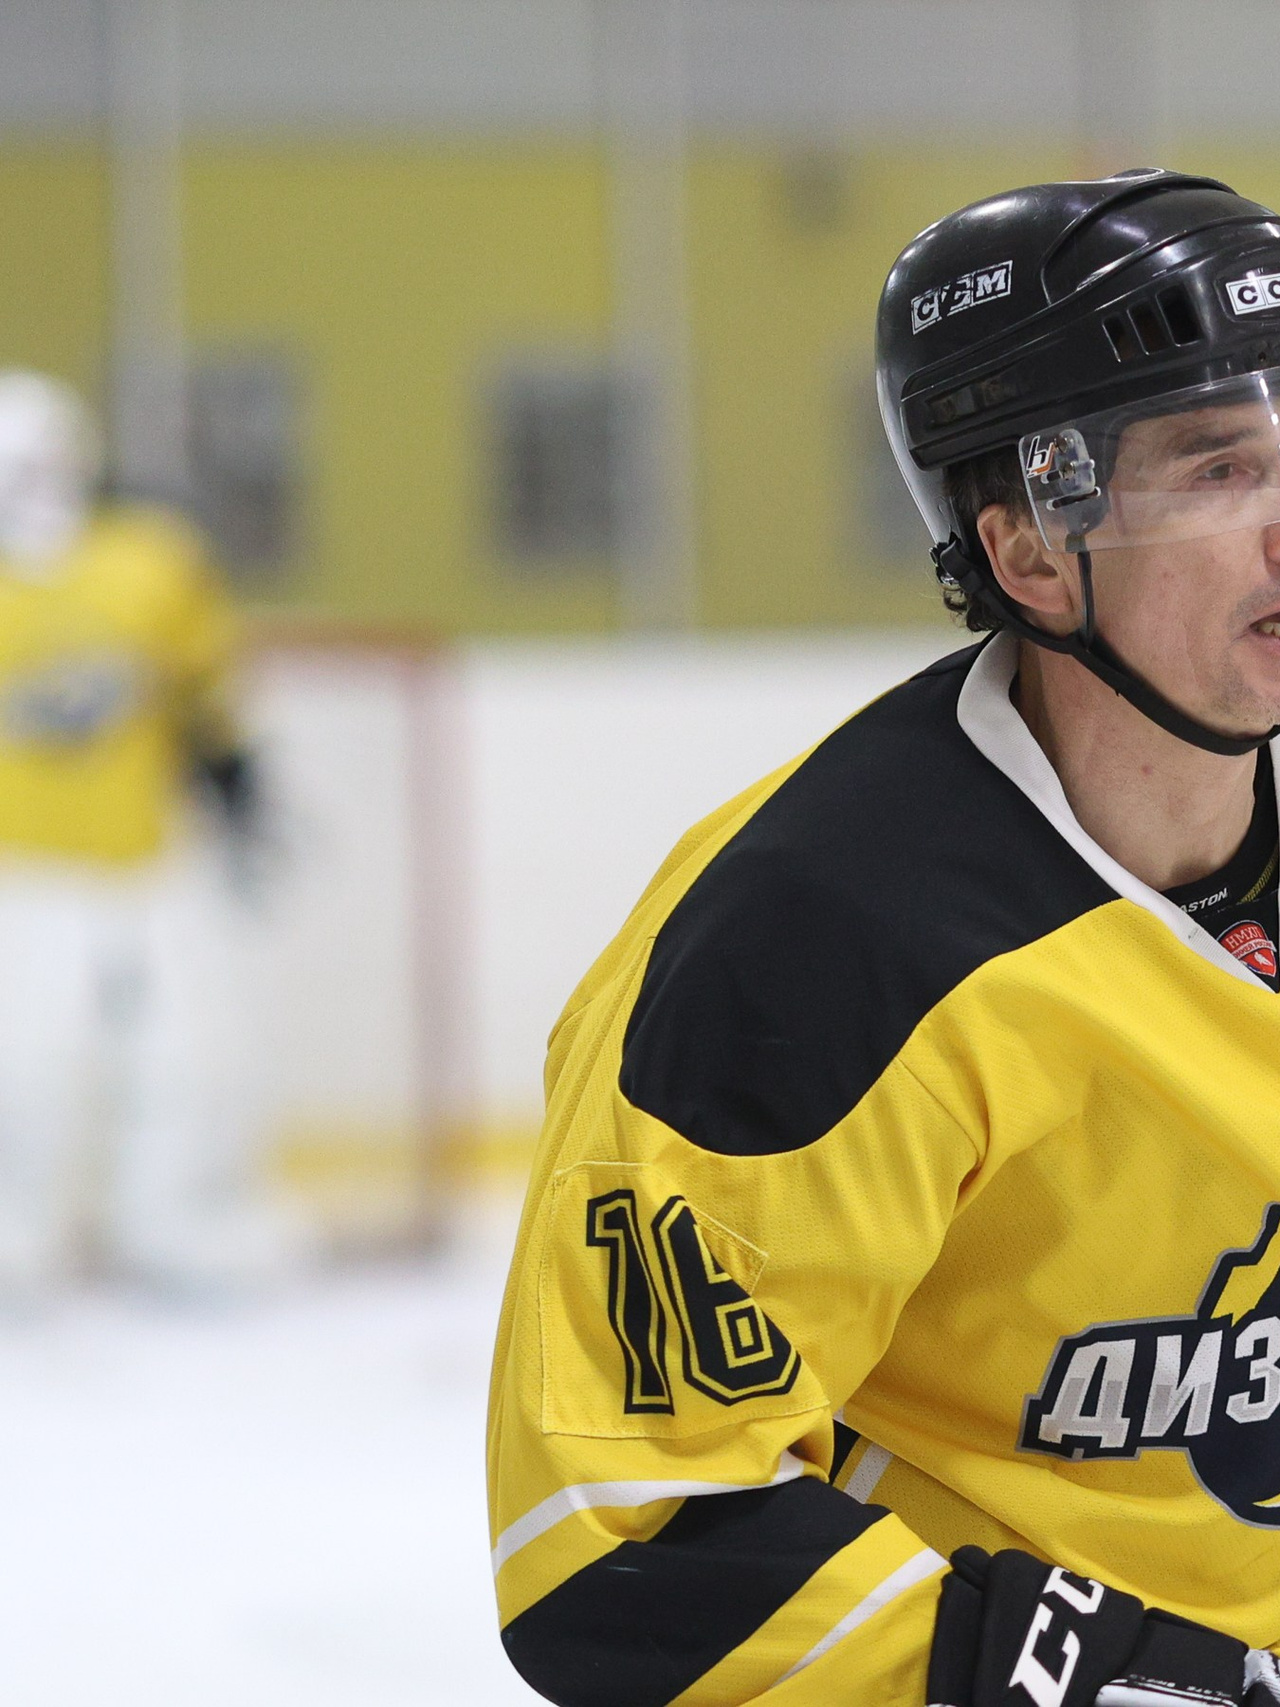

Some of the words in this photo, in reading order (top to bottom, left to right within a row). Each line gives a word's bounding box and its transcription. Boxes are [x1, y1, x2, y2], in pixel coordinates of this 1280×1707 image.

[1180, 887, 1228, 913] ASTON
[586, 1189, 802, 1416] 16
[1008, 1566, 1105, 1707] CC
